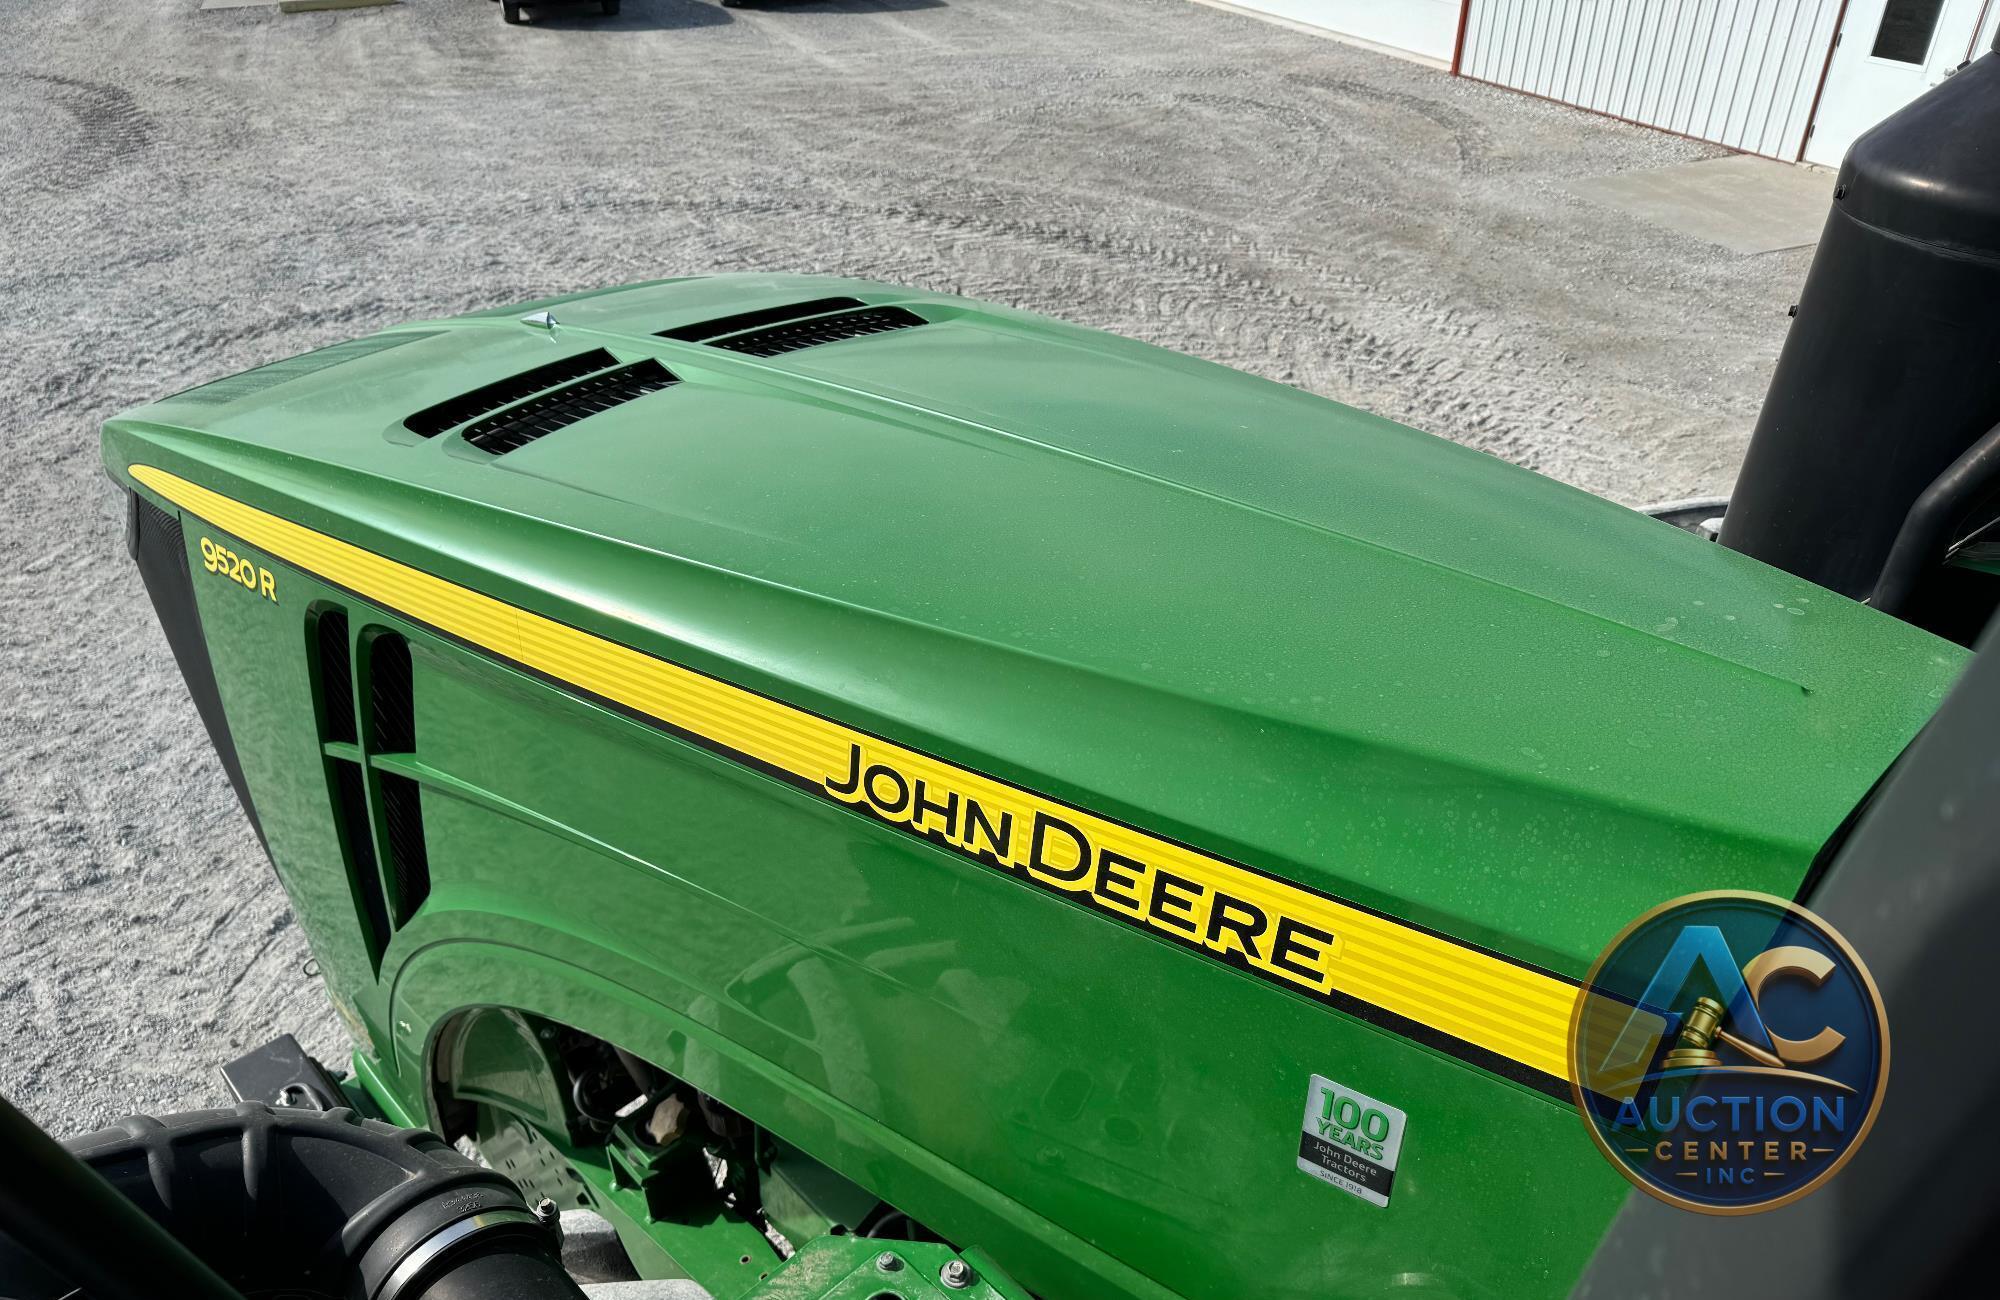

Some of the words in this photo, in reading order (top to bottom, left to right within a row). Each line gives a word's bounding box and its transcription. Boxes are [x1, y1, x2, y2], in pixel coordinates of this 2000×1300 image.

[201, 536, 257, 591] 9520
[825, 743, 1013, 859] JOHN
[1029, 810, 1335, 984] DEERE
[1320, 1086, 1390, 1142] 100
[1314, 1141, 1341, 1160] John
[1343, 1154, 1377, 1176] Deere
[1315, 1116, 1384, 1161] YEARS
[1320, 1169, 1343, 1186] SINCE
[1345, 1181, 1362, 1195] 1918
[1321, 1153, 1367, 1183] Tractors
